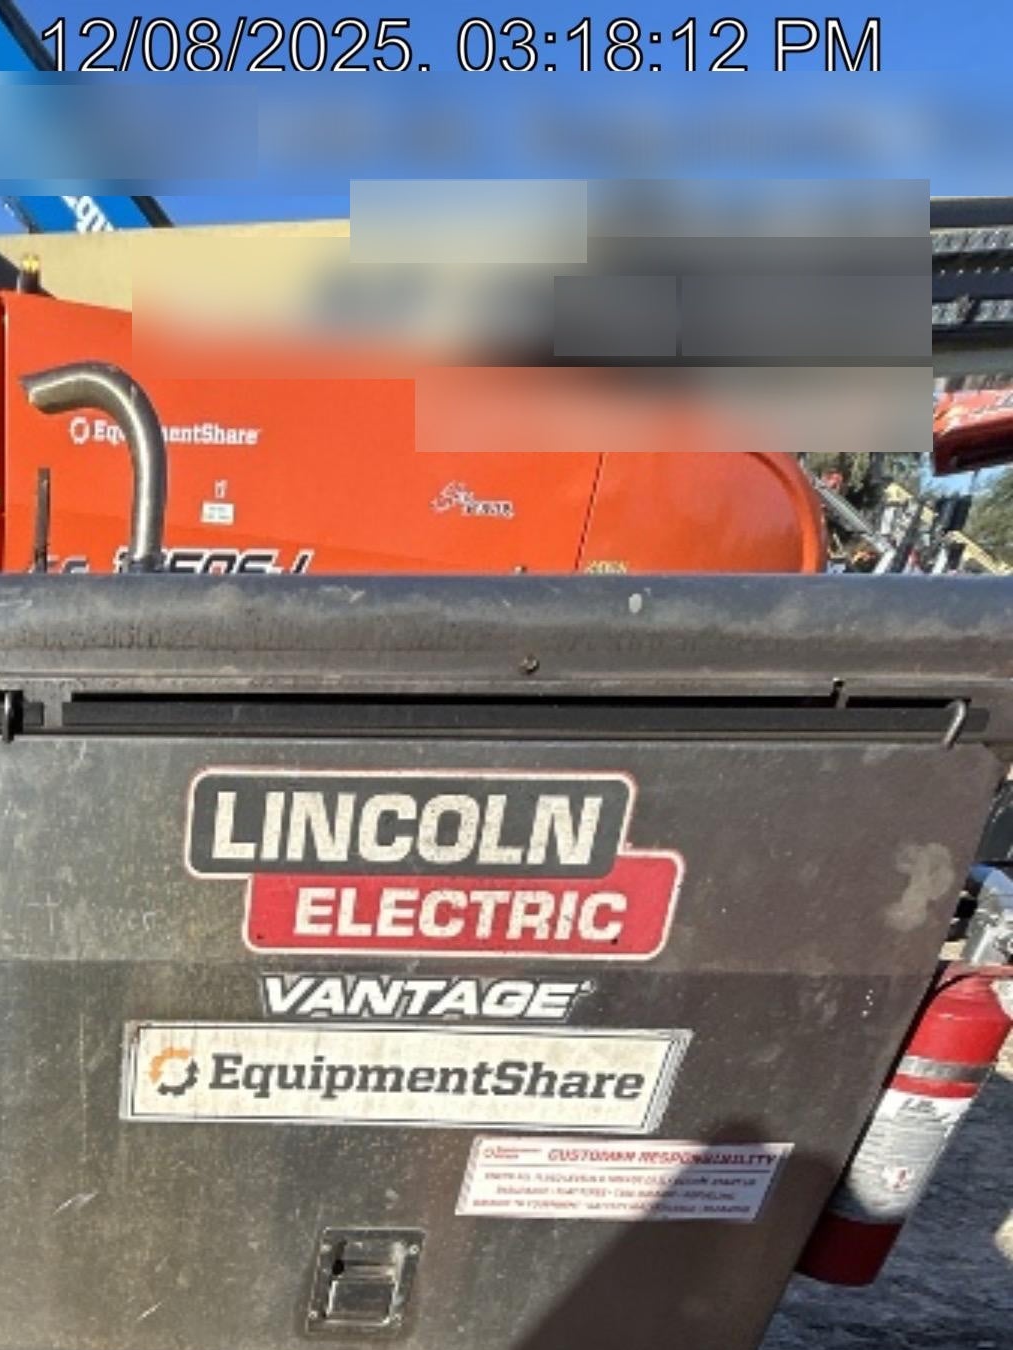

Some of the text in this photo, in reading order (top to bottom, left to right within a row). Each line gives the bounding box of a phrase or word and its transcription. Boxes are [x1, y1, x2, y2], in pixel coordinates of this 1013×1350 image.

[211, 791, 604, 866] LINCOLN
[293, 886, 629, 942] ELECTRIC
[209, 1052, 645, 1100] EquipmentShare
